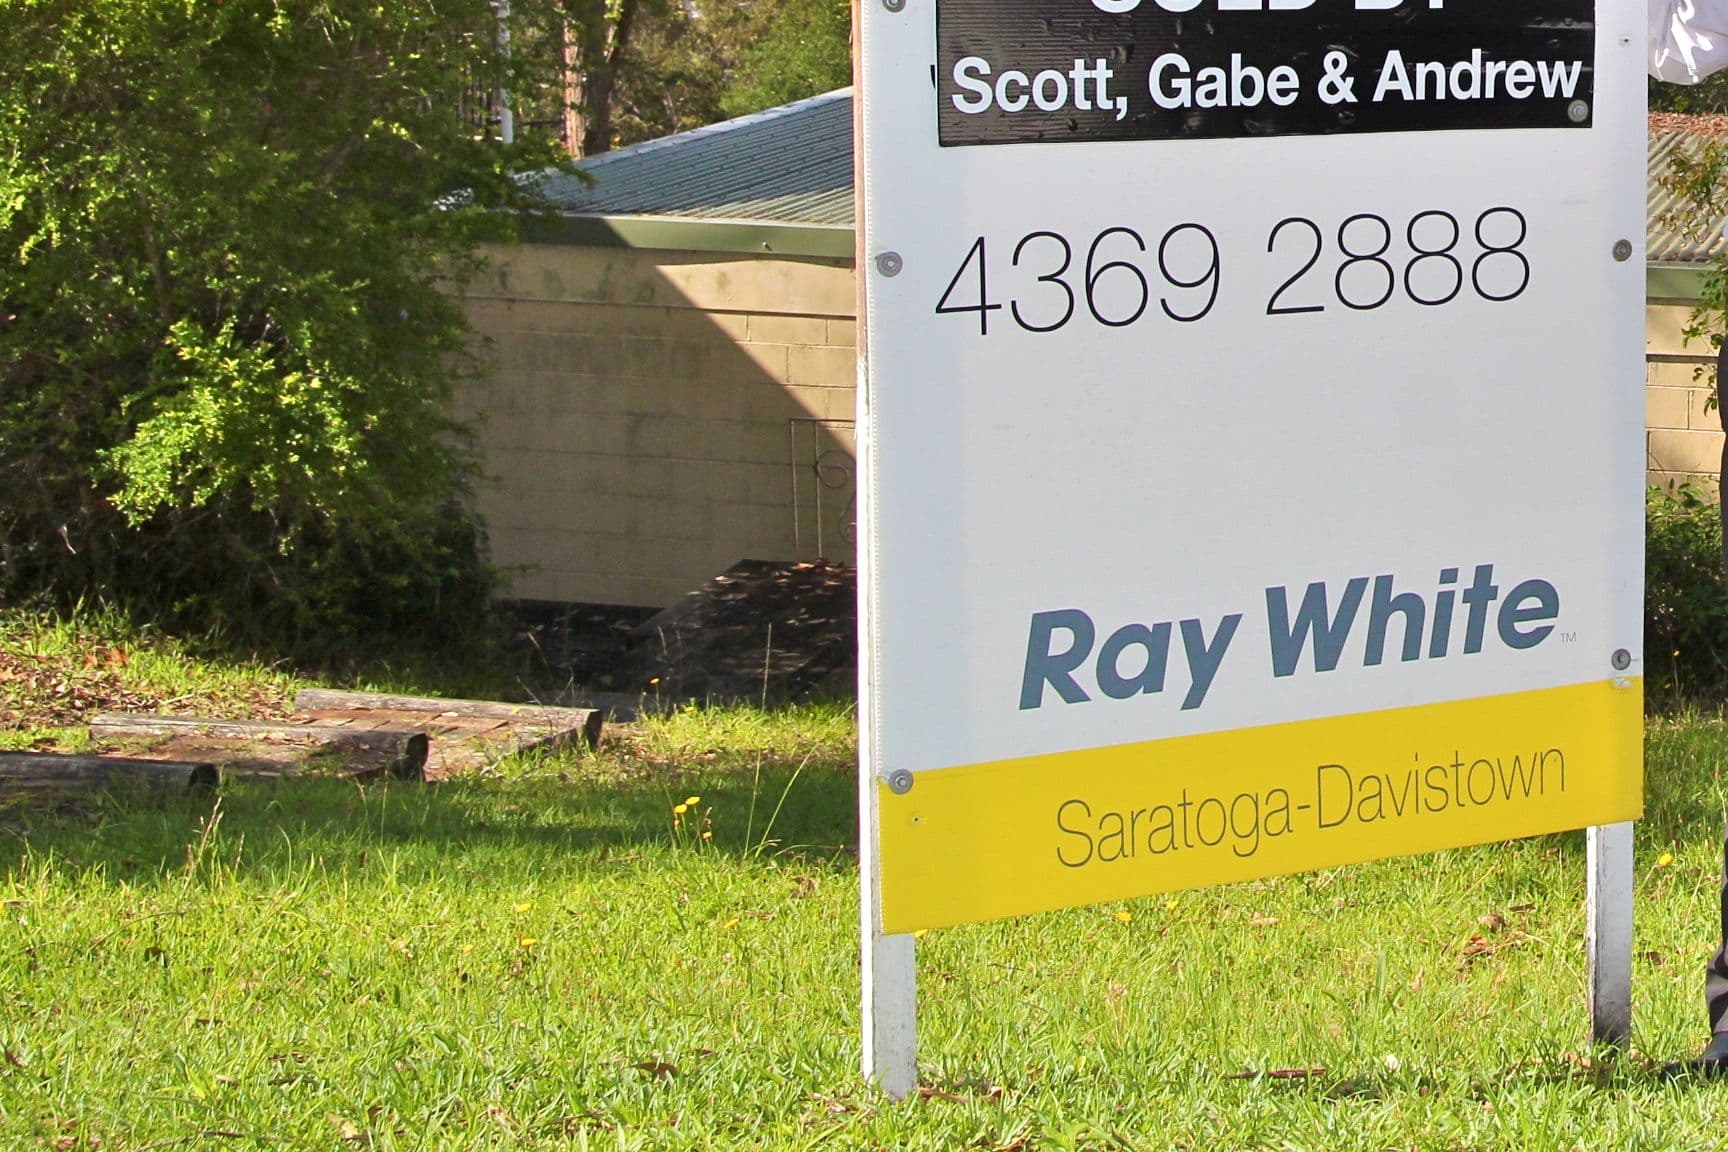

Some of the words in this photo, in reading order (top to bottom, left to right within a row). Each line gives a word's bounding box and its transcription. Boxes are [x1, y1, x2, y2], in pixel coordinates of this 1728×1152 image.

[951, 56, 1129, 121] Scott,
[1148, 53, 1300, 109] Gabe
[1317, 50, 1358, 105] &
[1372, 48, 1584, 102] Andrew
[935, 222, 1221, 336] 4369
[1265, 206, 1530, 316] 2888
[1018, 608, 1244, 711] Ray
[1265, 563, 1561, 678] White
[1056, 748, 1565, 868] Saratoga-Davistown
